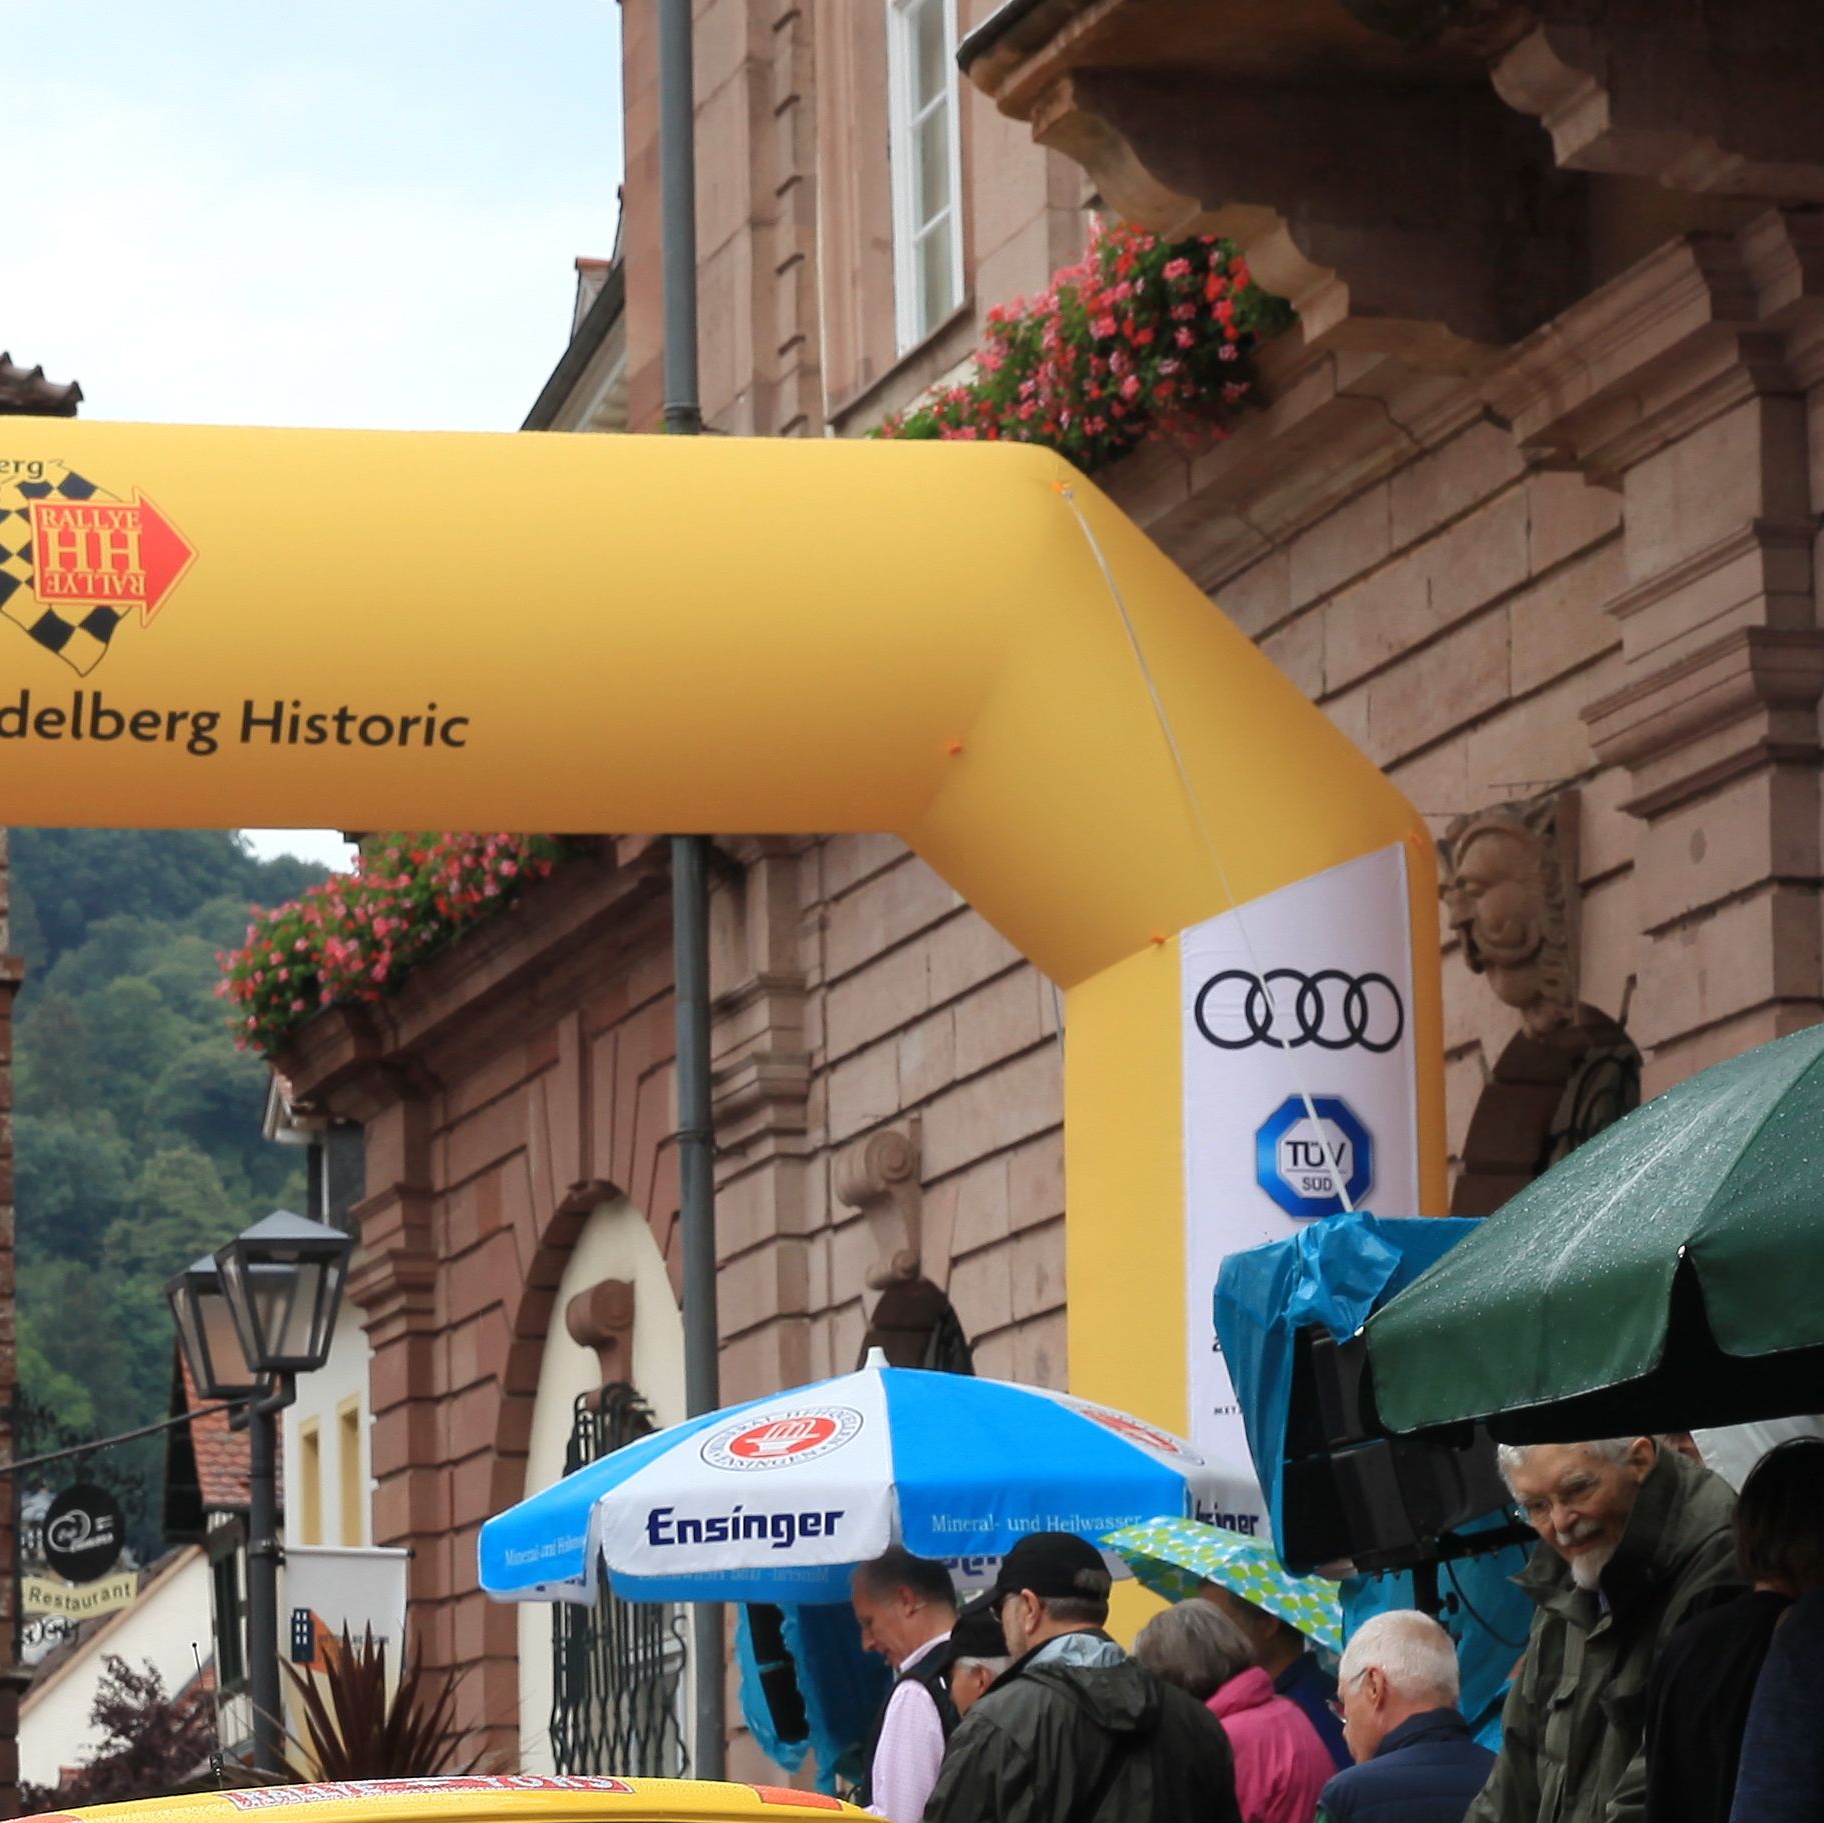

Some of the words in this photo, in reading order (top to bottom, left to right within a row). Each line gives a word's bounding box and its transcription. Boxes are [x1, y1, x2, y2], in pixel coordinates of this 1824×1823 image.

[40, 507, 142, 531] RALLYE
[45, 526, 147, 576] HH
[238, 697, 470, 753] Historic
[1285, 1140, 1347, 1170] TÜV
[1301, 1175, 1334, 1193] SÜD
[645, 1505, 846, 1550] Ensinger
[931, 1512, 1001, 1533] Mineral-
[1008, 1513, 1042, 1533] und
[1045, 1512, 1144, 1534] Heilwasser
[28, 1582, 131, 1612] Restaurant
